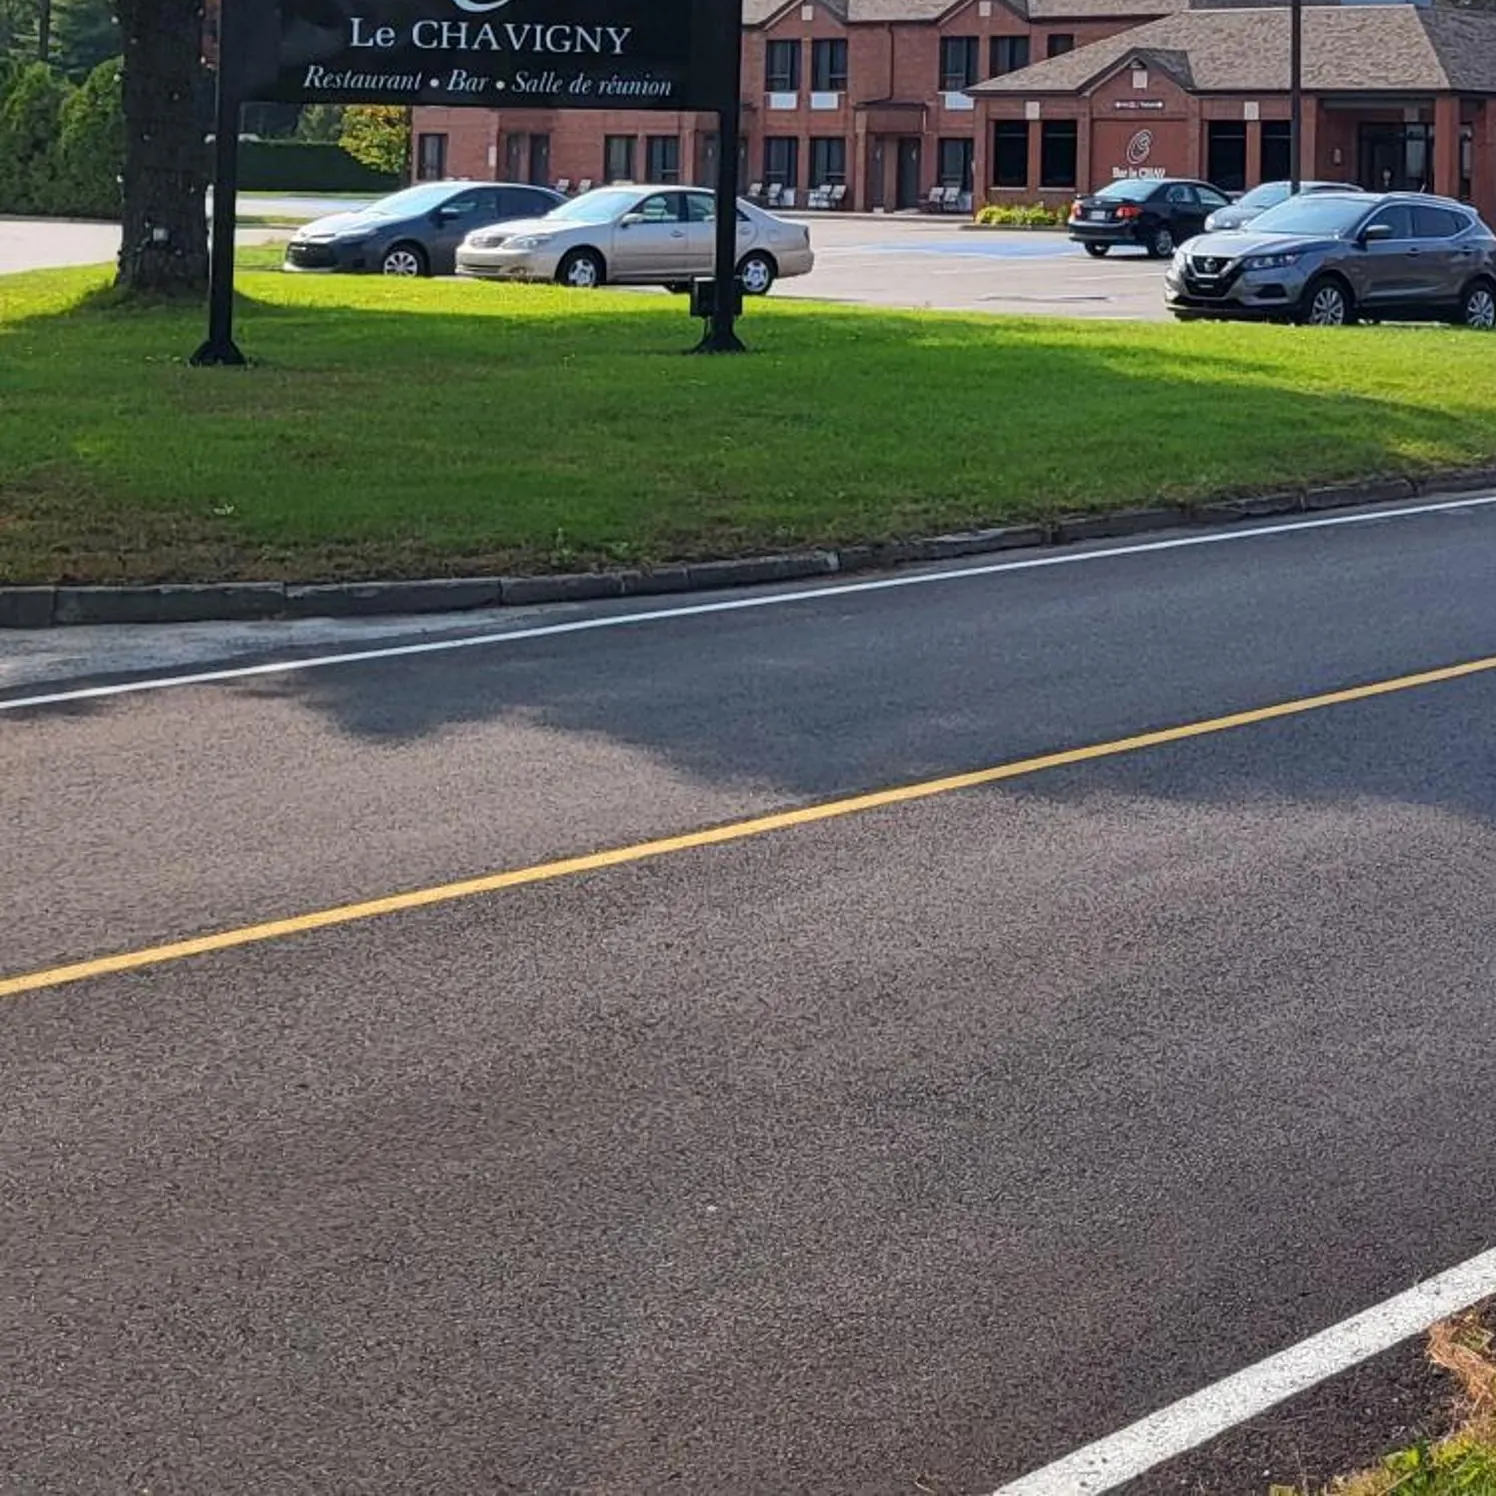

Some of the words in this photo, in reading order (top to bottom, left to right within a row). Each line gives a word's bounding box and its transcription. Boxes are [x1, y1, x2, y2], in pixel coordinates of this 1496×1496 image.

[350, 17, 396, 48] Le
[411, 19, 632, 54] CHAVIGNY
[302, 64, 422, 91] Restaurant
[446, 68, 489, 92] Bar
[511, 70, 562, 94] Salle
[568, 72, 592, 95] de
[598, 75, 673, 97] réunion
